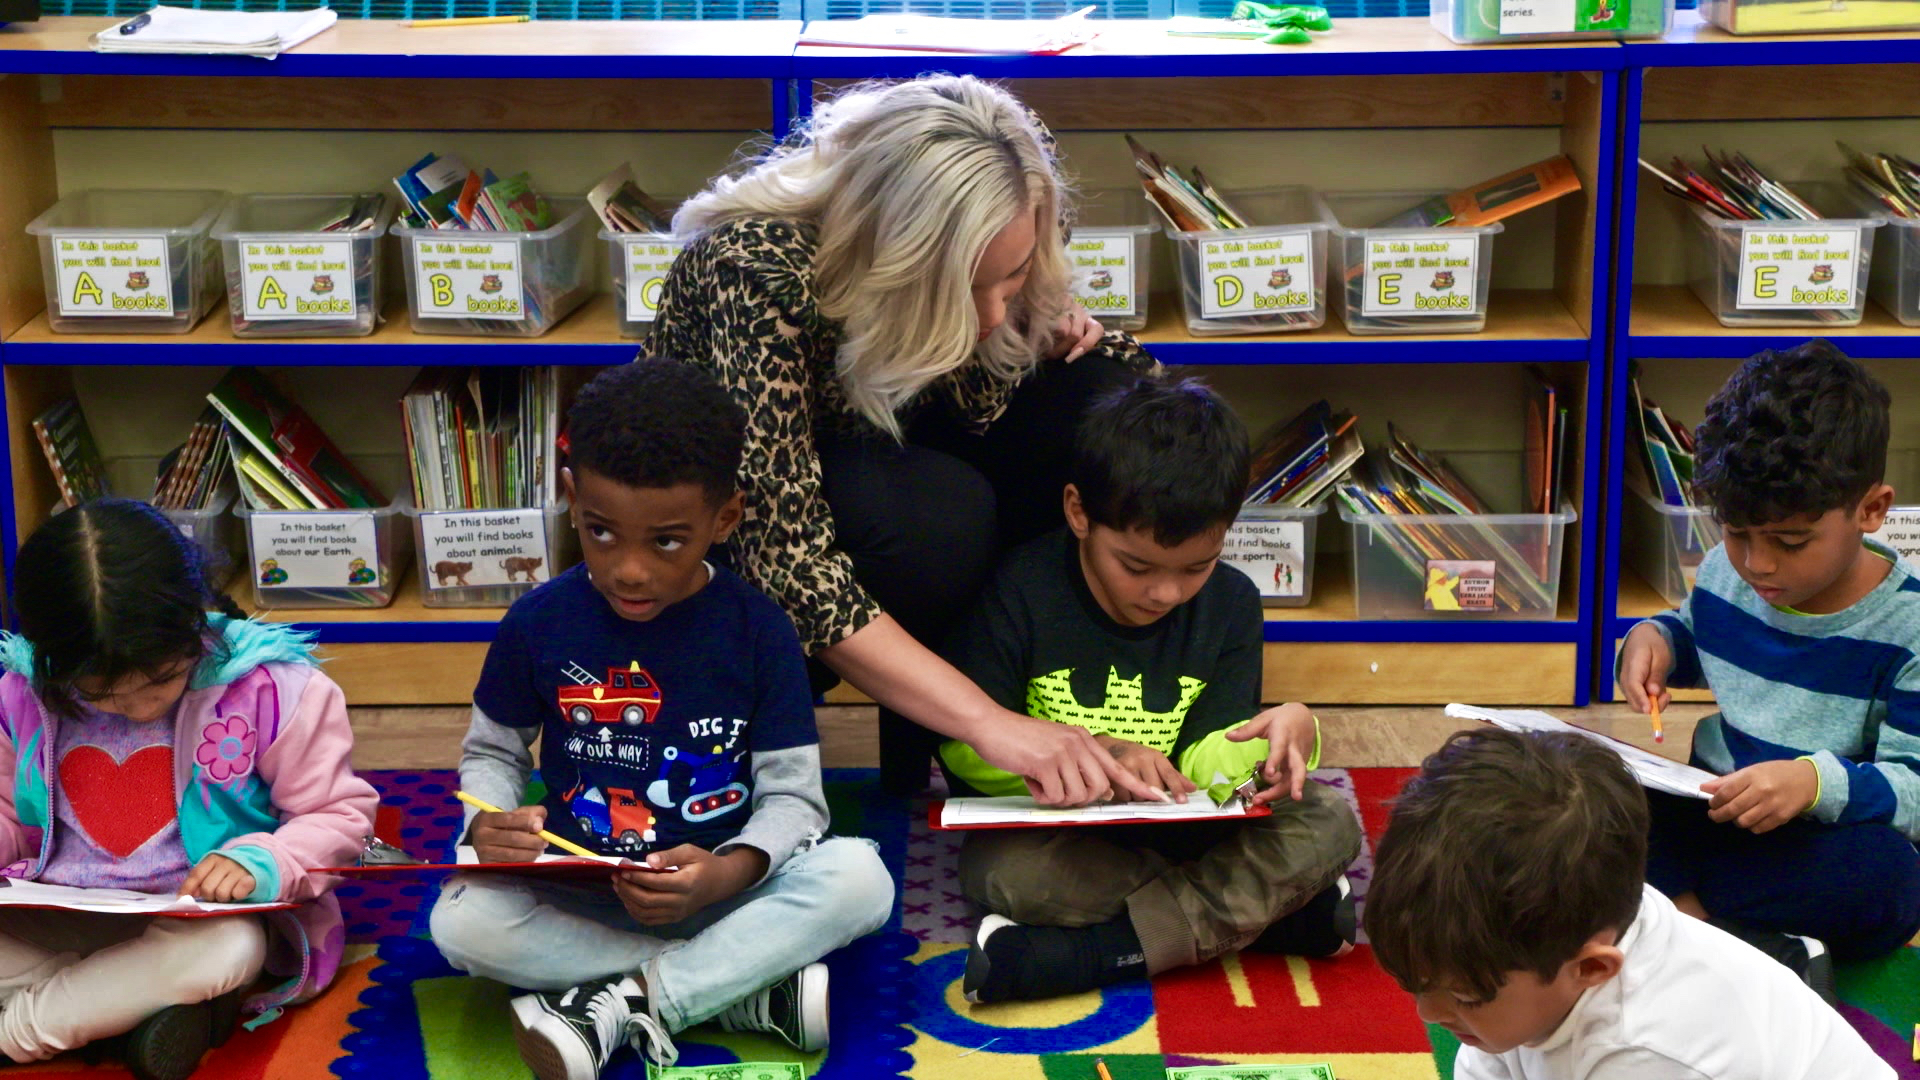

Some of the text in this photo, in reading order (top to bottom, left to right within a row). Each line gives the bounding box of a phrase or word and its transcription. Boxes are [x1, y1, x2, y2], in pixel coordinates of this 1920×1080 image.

[1503, 7, 1535, 18] series.
[1750, 233, 1829, 244] In this basket
[62, 241, 138, 250] In this basket
[248, 245, 324, 255] In this basket
[420, 243, 492, 254] In this basket
[632, 246, 644, 256] In
[648, 245, 668, 256] this
[1070, 241, 1104, 250] basket
[1207, 240, 1282, 254] In this basket
[1372, 242, 1449, 253] In this basket
[1076, 256, 1125, 266] find level
[1748, 250, 1849, 262] you will find level
[63, 256, 160, 268] you will find level
[248, 260, 346, 273] you will find level
[422, 259, 513, 270] you will find level
[633, 263, 652, 272] you
[1208, 254, 1304, 272] you will find level
[1372, 257, 1469, 271] you will find level
[1754, 265, 1848, 303] E books
[73, 271, 167, 309] A books
[258, 276, 352, 313] A books
[429, 273, 519, 312] B books
[1214, 275, 1308, 308] D books
[1378, 274, 1469, 308] E books
[444, 516, 520, 528] In this basket
[1884, 516, 1896, 524] In
[281, 522, 346, 532] In this basket
[1228, 526, 1280, 534] his basket
[272, 536, 357, 545] you will find books
[435, 530, 534, 546] you will find books
[1238, 539, 1258, 547] find
[1262, 540, 1291, 549] books
[276, 548, 301, 556] about
[447, 549, 477, 558] about
[688, 717, 748, 738] DIG I
[568, 738, 642, 763] ON OUR WAY
